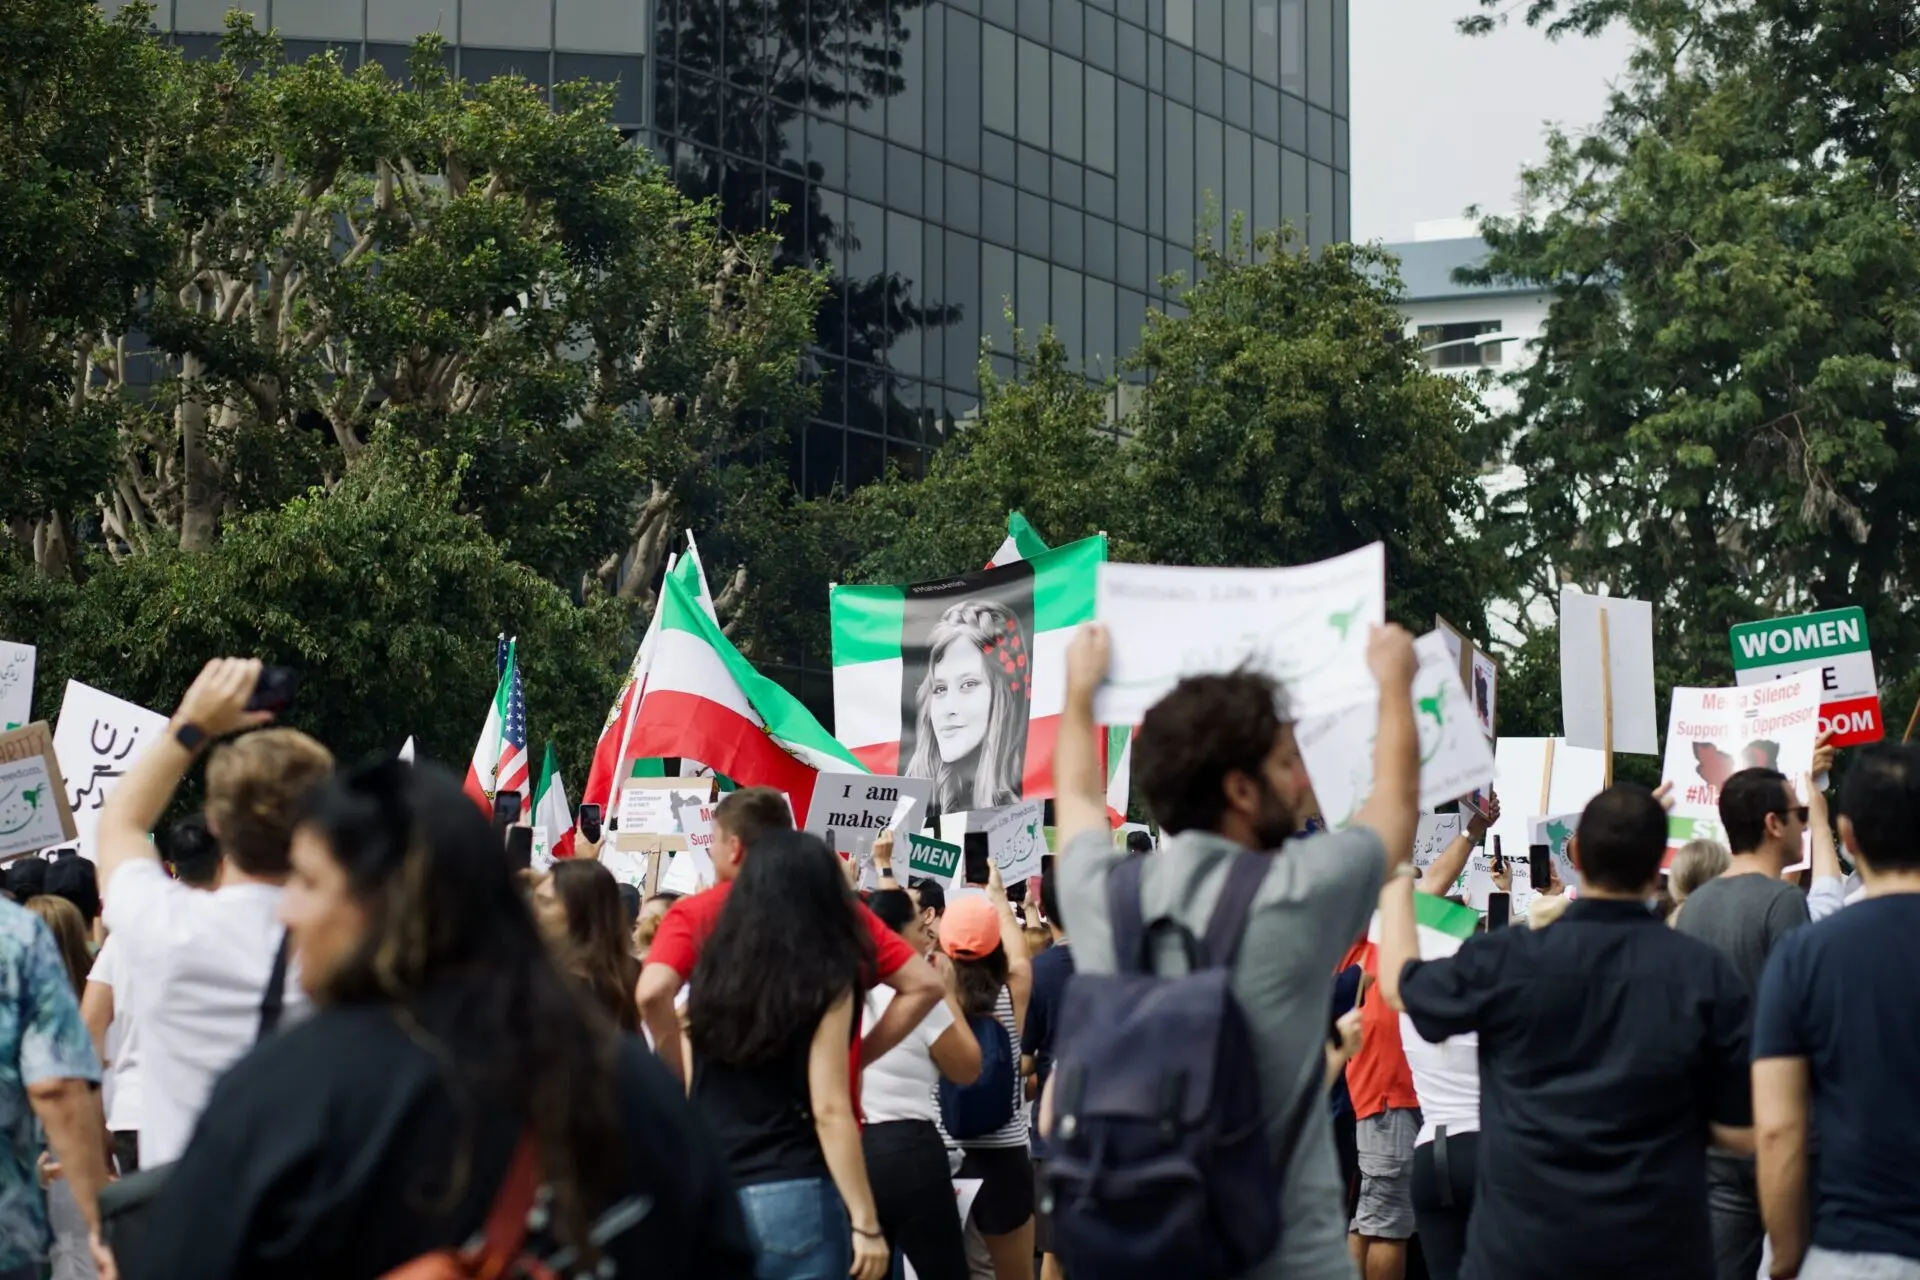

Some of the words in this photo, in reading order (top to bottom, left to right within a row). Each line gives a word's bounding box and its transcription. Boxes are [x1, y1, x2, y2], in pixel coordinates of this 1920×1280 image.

[1738, 618, 1860, 659] WOMEN
[1753, 683, 1801, 706] Silence
[1752, 705, 1815, 734] Oppressor
[91, 719, 138, 759] زن
[842, 784, 852, 798] I
[865, 786, 898, 801] am
[911, 843, 955, 869] MEN
